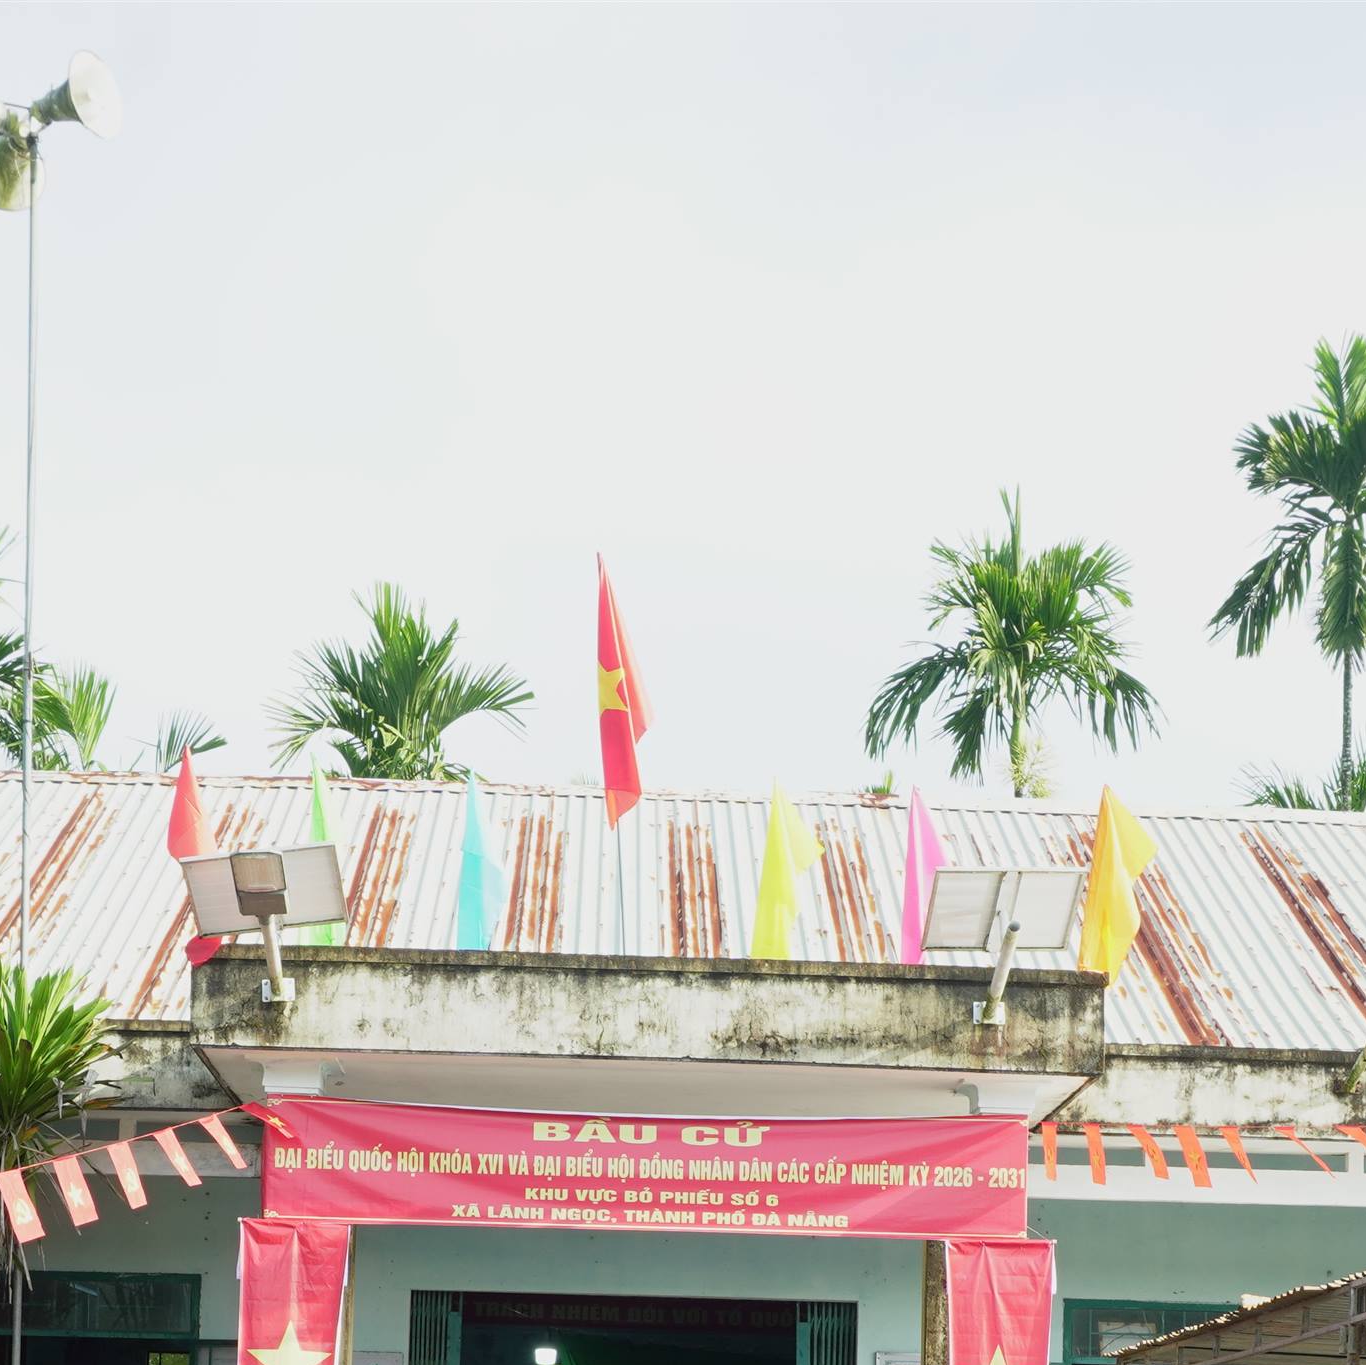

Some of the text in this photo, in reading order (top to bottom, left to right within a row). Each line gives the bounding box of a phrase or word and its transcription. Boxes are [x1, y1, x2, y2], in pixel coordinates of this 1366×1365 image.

[532, 1117, 770, 1147] BẦU CỬ
[274, 1147, 302, 1173] ĐẠI
[306, 1140, 344, 1170] BIỂU
[348, 1143, 392, 1172] QUỐC
[397, 1147, 424, 1177] HỘI
[429, 1148, 472, 1175] KHÓA
[477, 1152, 504, 1175] XVI
[508, 1149, 530, 1176] VÀ
[533, 1154, 561, 1180] ĐẠI
[565, 1148, 603, 1178] BIỂU
[607, 1154, 635, 1183] HỘI
[639, 1152, 684, 1180] ĐỒNG
[688, 1156, 734, 1182] NHÂN
[739, 1157, 773, 1183] DÂN
[777, 1157, 810, 1184] CÁC
[814, 1156, 846, 1185] CẤP
[851, 1160, 904, 1190] NHIỆM
[908, 1161, 929, 1187] KỲ
[933, 1167, 973, 1187] 2026
[988, 1167, 1026, 1189] 2031
[525, 1186, 779, 1206] KHU VỰC BỎ PHIẾU SỐ 6
[451, 1203, 849, 1228] XÃ LÃNH NGỌC, THÀNH PHỐ ĐÀ NẴNG
